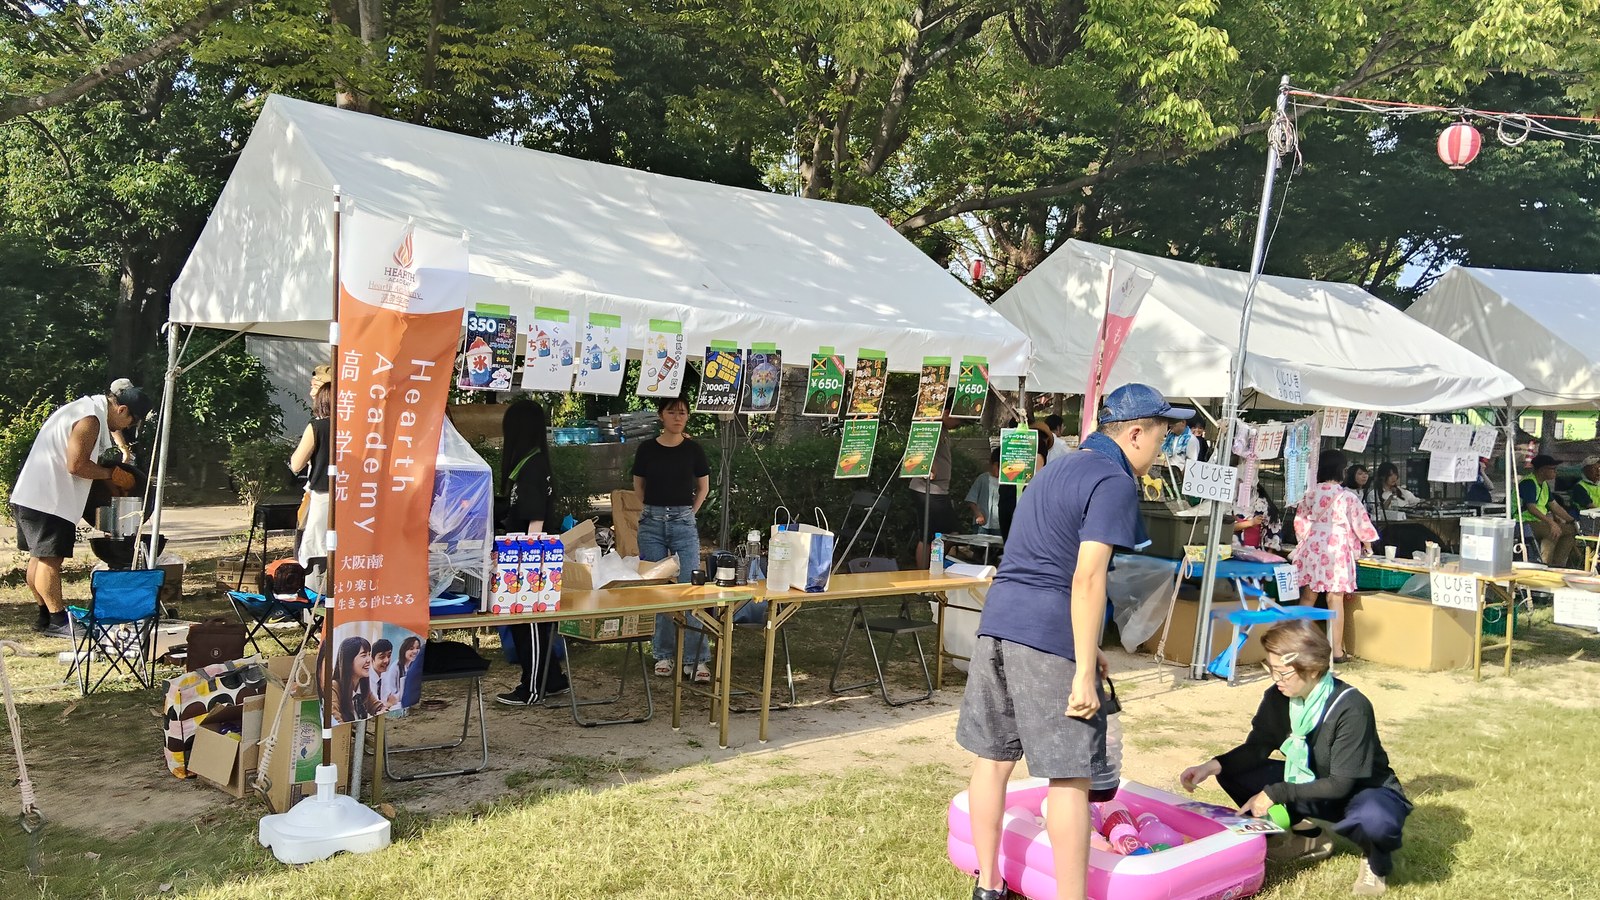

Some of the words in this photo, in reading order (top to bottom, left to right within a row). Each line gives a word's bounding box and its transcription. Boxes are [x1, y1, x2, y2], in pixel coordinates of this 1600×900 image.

[384, 266, 416, 282] HEARTH
[468, 316, 507, 334] 350円
[472, 354, 489, 372] 氷
[393, 359, 436, 491] Hearth
[353, 351, 395, 534] Academy
[1189, 462, 1234, 485] くじびき
[1184, 481, 1231, 500] 300円
[1433, 574, 1473, 594] くじびき
[1433, 592, 1474, 608] 300円
